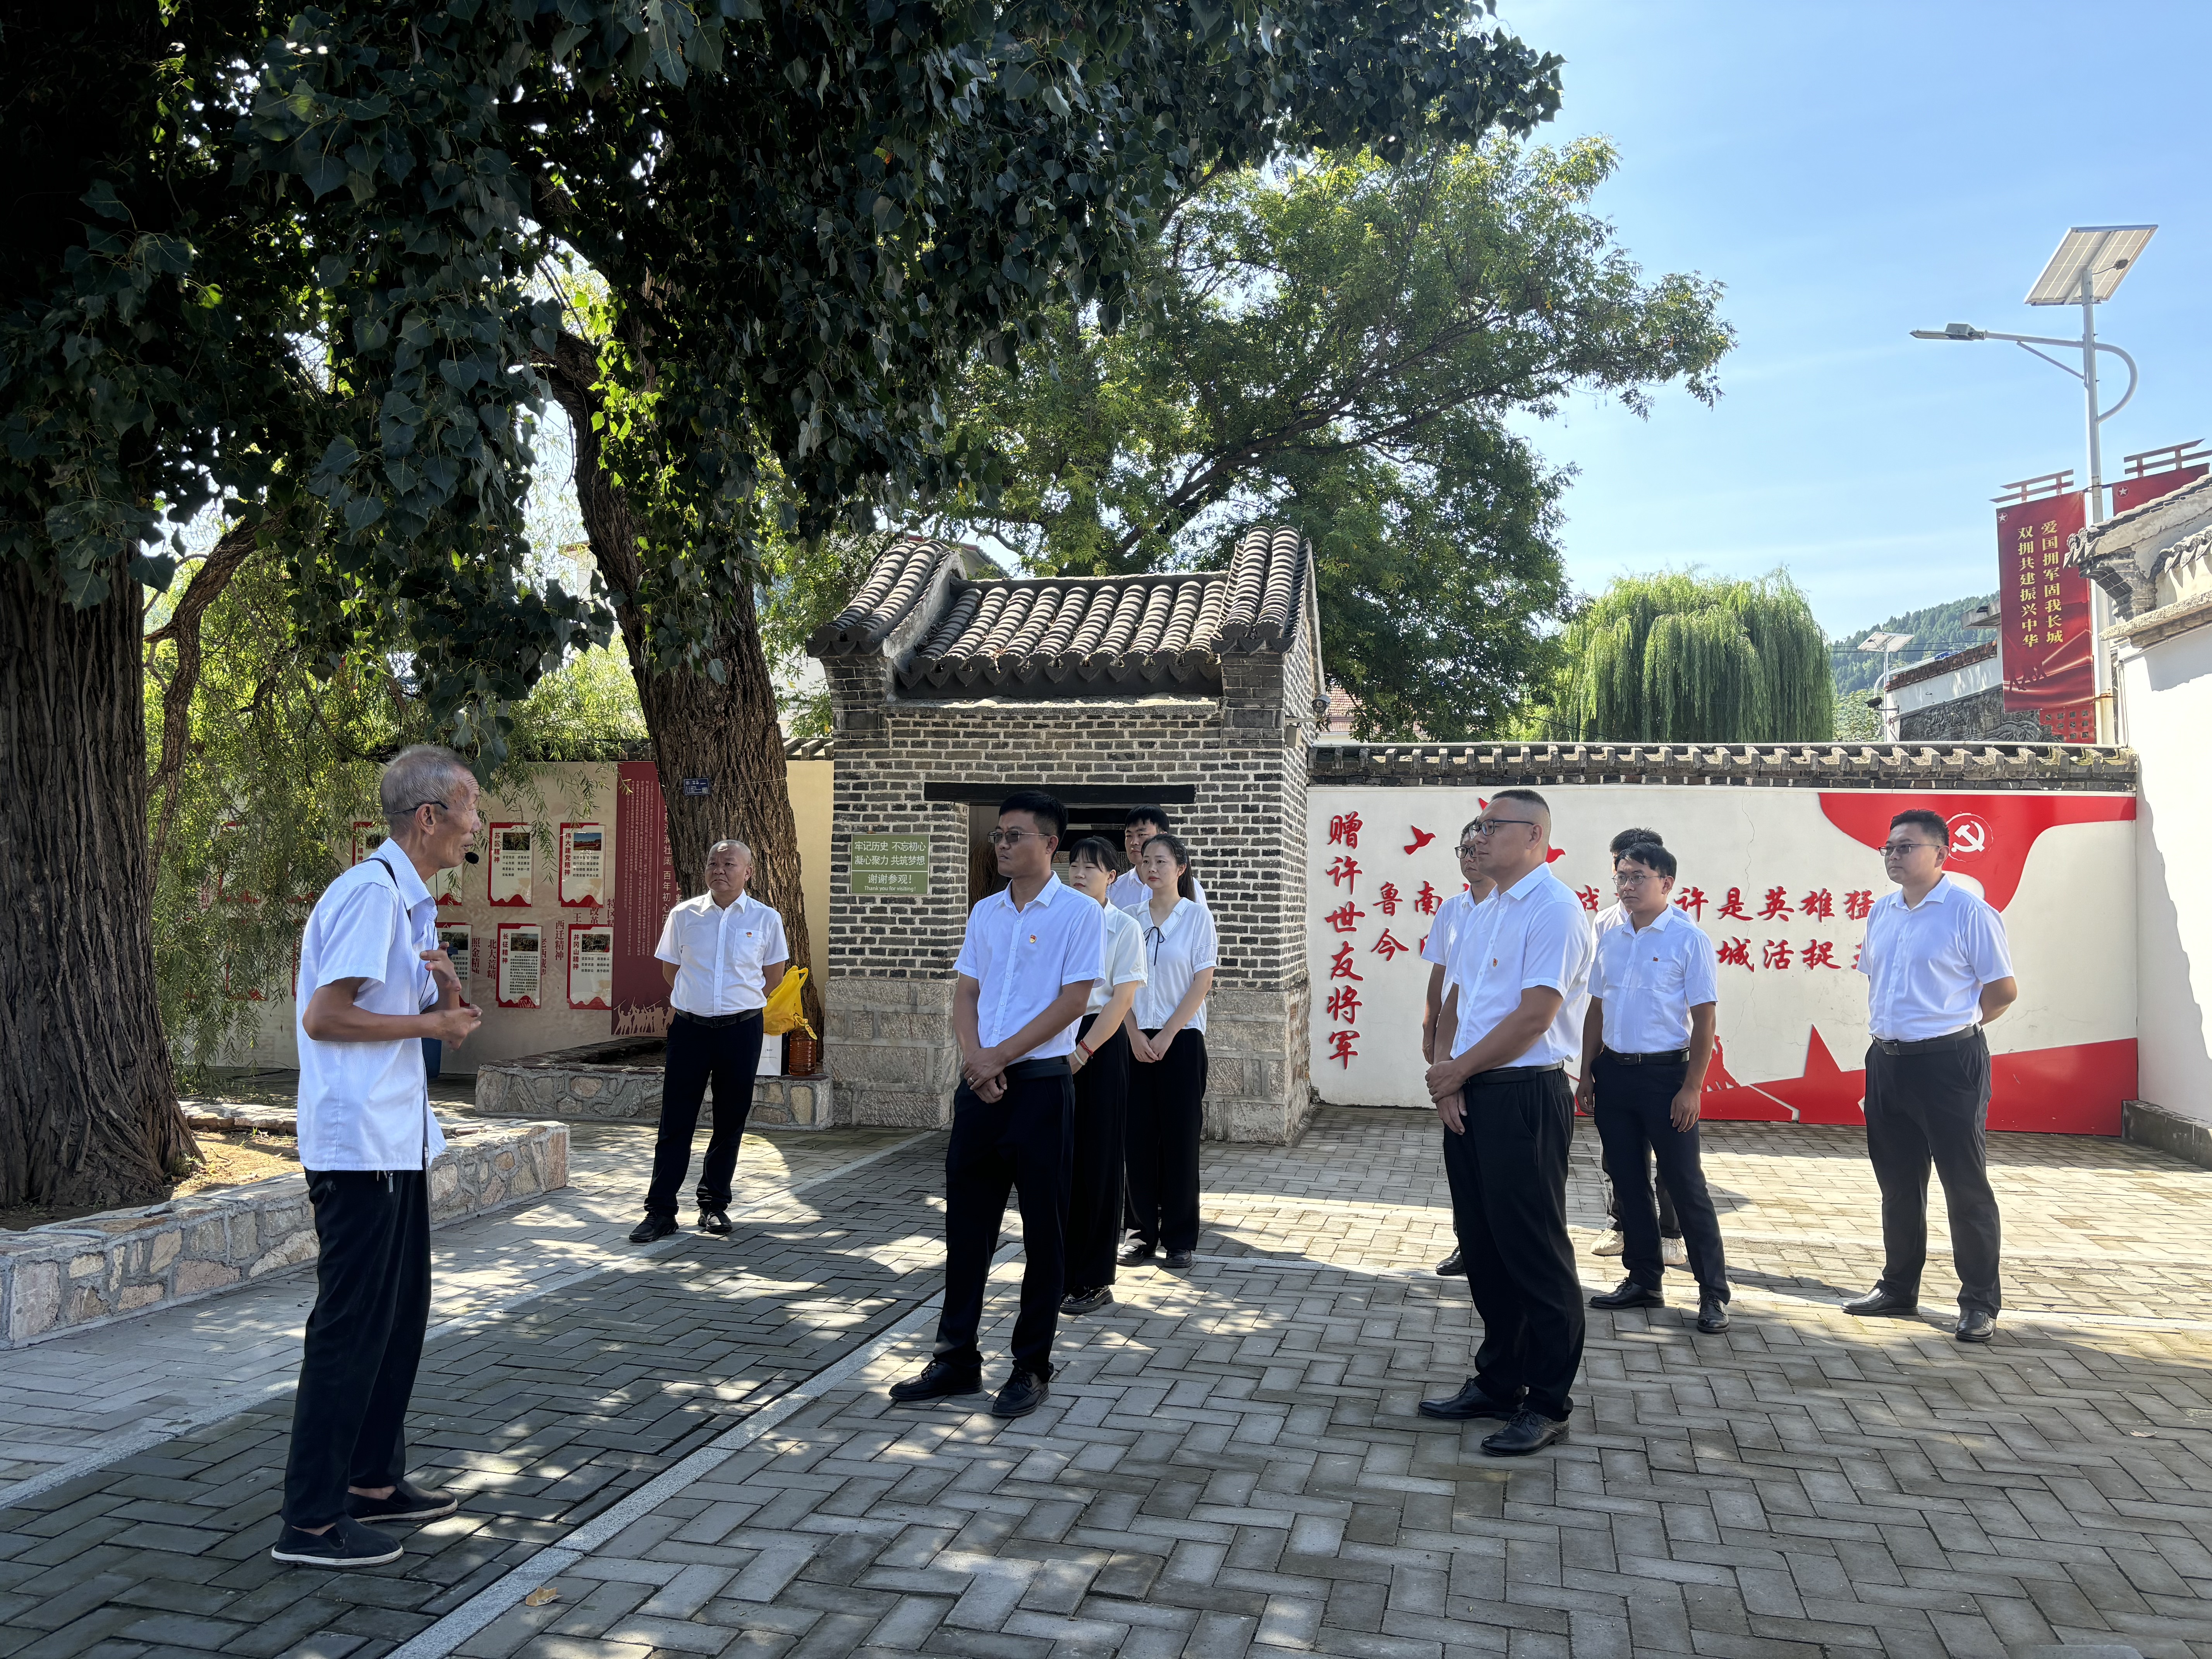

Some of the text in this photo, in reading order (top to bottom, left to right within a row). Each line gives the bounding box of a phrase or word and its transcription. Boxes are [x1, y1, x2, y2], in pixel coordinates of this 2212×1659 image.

[2017, 525, 2039, 647] 双拥共建振兴中华
[2041, 520, 2063, 644] 爱国拥军固我长城
[854, 841, 926, 851] 牢记历史 不忘初心
[855, 855, 925, 866] 凝心聚力 共筑梦想
[868, 874, 912, 884] 谢谢参观！
[573, 912, 582, 924] 王
[555, 920, 565, 960] 西迁精神
[1325, 811, 1365, 1070] 赠许世友将军
[1371, 928, 1429, 961] 今
[487, 939, 497, 979] 北大荒精
